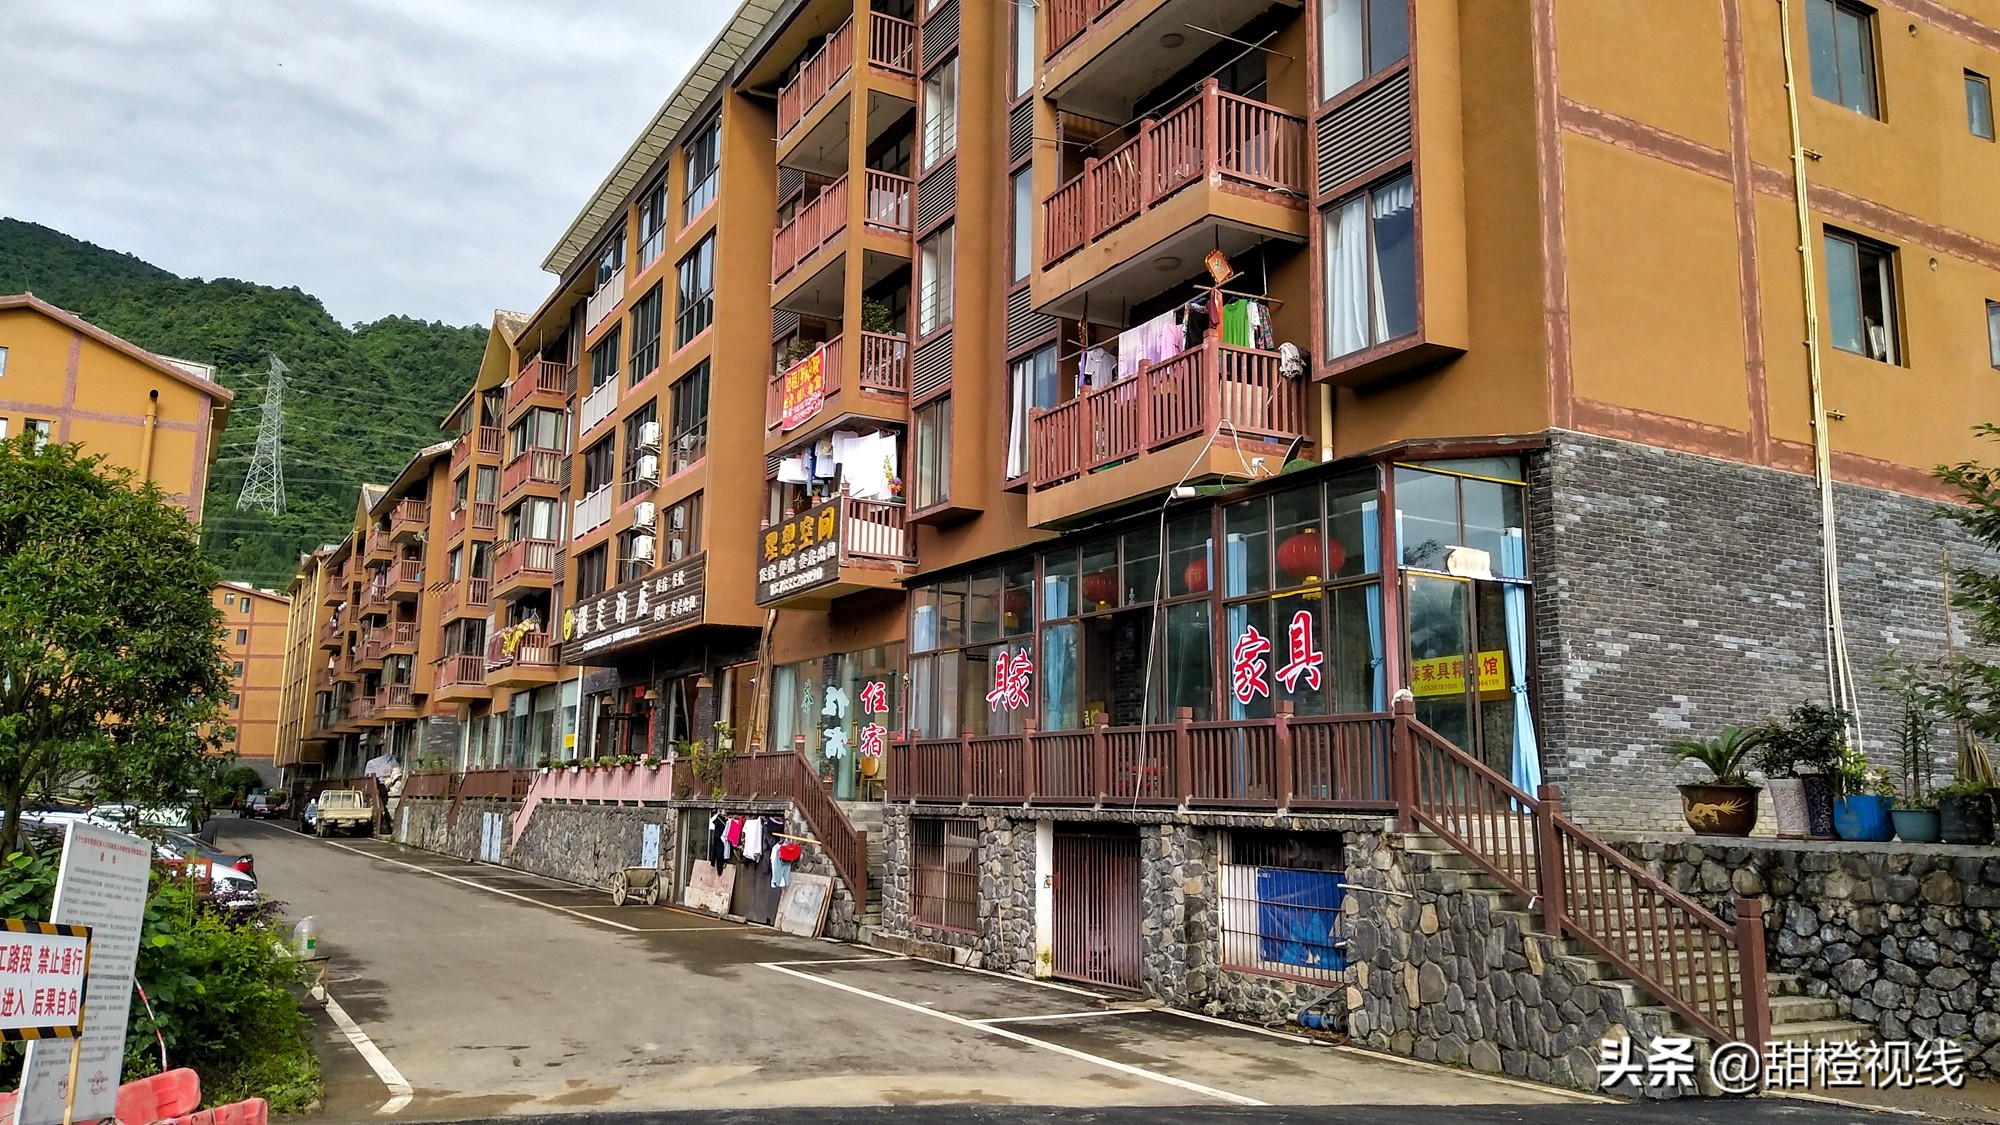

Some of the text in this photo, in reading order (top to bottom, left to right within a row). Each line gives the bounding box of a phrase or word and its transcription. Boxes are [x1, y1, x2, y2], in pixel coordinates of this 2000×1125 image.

[764, 506, 835, 562] 理想空间
[1232, 609, 1324, 706] 家具
[860, 680, 889, 758] 住宿
[37, 945, 83, 976] 禁止通行
[31, 986, 79, 1017] 后果自负
